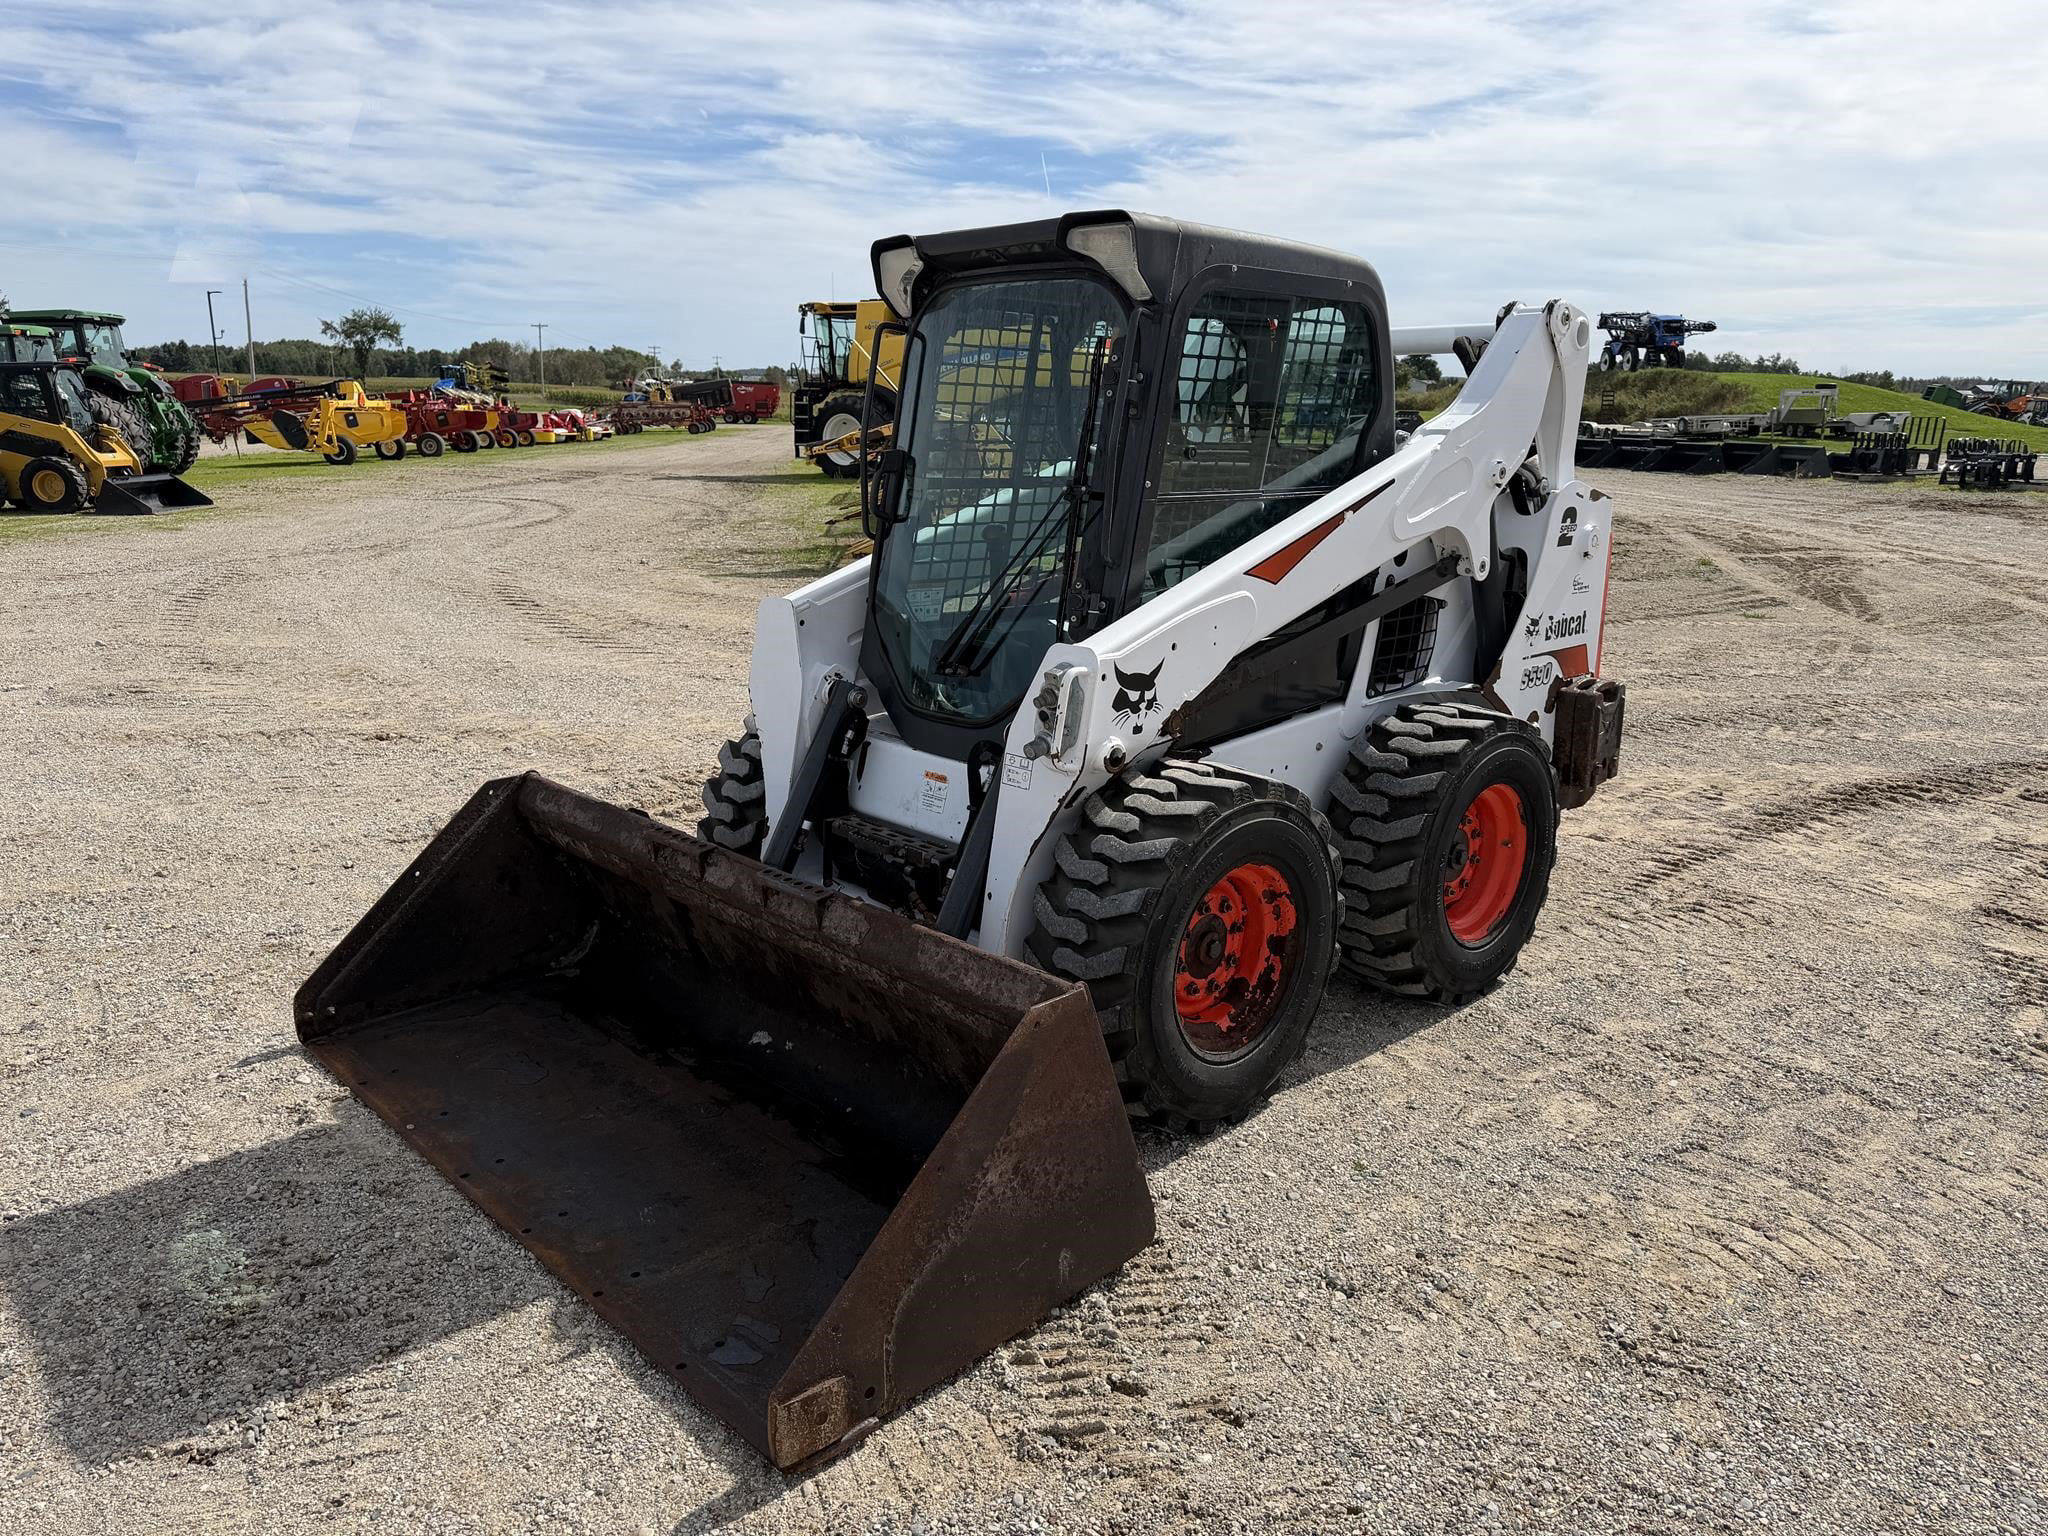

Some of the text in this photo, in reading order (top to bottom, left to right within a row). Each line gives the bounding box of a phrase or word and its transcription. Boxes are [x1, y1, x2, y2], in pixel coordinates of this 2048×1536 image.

[1557, 506, 1578, 547] 2
[1560, 523, 1578, 534] SPEED
[1545, 610, 1587, 641] Bobcat
[1519, 661, 1553, 691] S590
